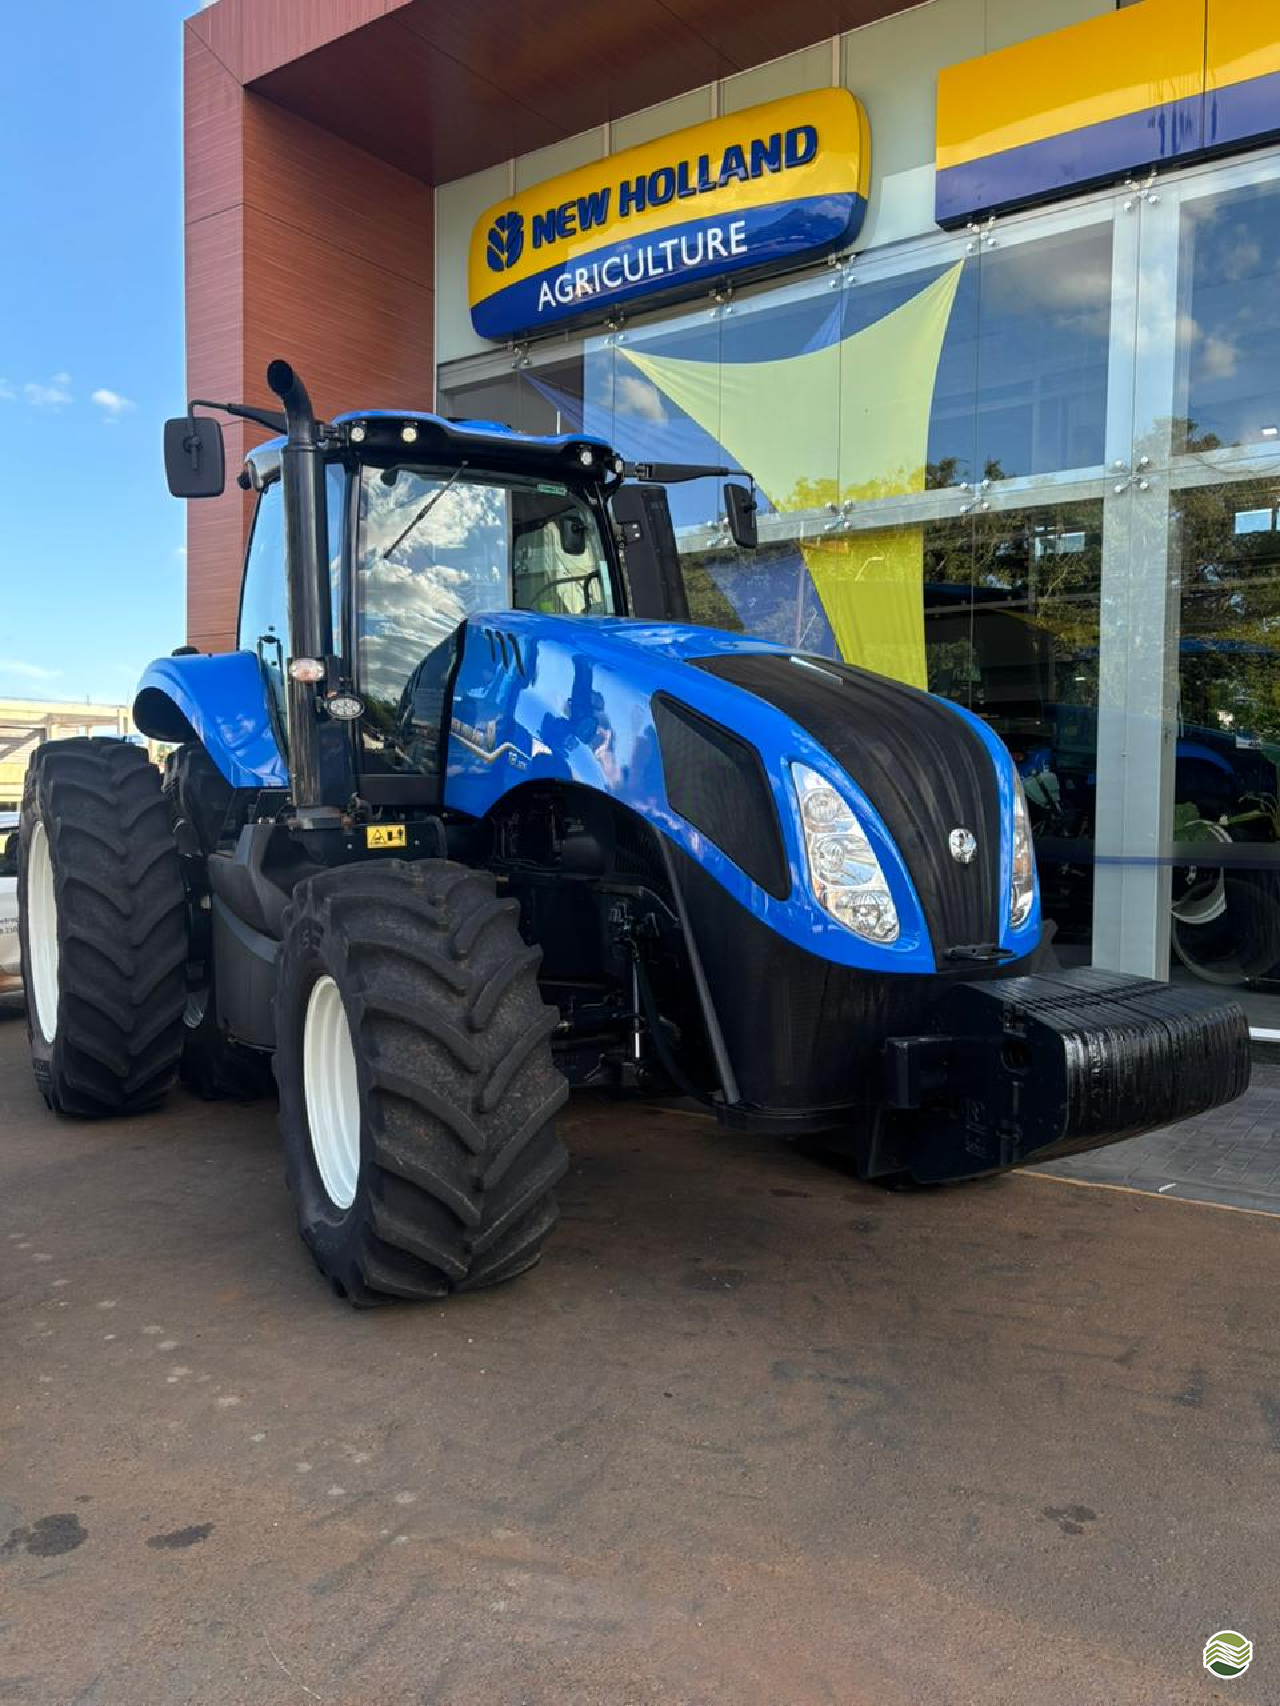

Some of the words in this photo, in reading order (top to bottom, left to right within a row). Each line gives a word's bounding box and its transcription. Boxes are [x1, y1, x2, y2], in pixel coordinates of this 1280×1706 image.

[532, 188, 611, 249] NEW
[618, 124, 818, 217] HOLLAND
[538, 220, 748, 311] AGRICULTURE
